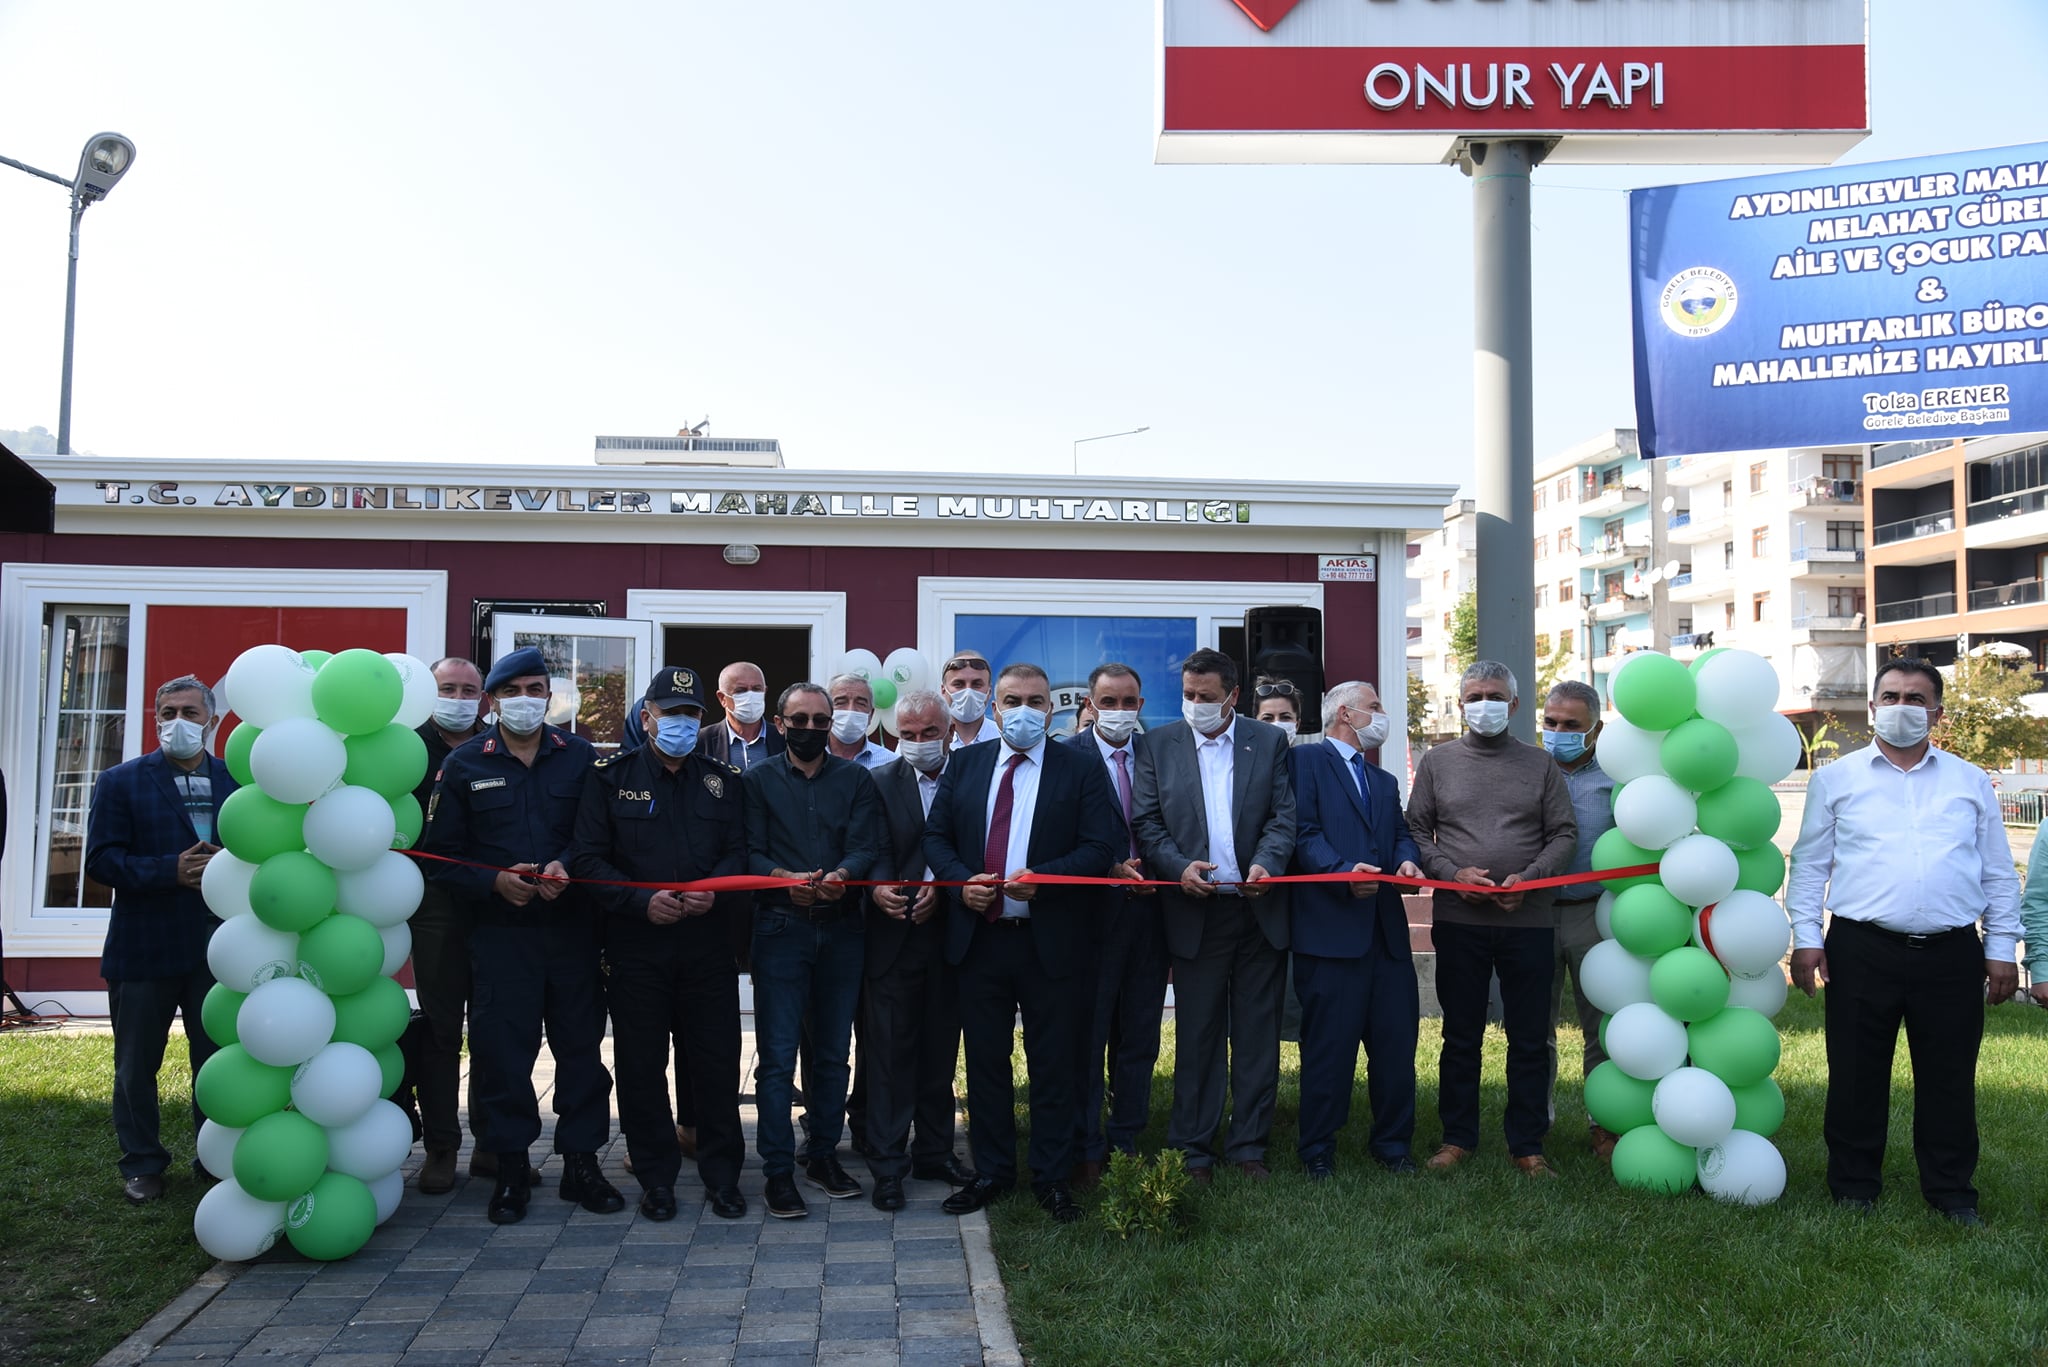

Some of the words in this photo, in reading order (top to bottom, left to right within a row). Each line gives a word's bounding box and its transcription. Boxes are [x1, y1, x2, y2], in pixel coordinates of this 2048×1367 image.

[1364, 61, 1534, 110] ONUR
[1548, 61, 1664, 109] YAPI
[1730, 174, 1957, 219] AYDINLIKEVLER
[1808, 207, 1950, 243] MELAHAT
[1771, 248, 1837, 279] AİLE
[1843, 248, 1880, 272] VE
[1887, 236, 1993, 274] ÇOCUK
[2001, 229, 2048, 257] PA
[1917, 277, 1947, 302] &
[1781, 313, 1955, 349] MUHTARLIK
[1962, 302, 2048, 334] BÜRO
[1713, 346, 1919, 387] MAHALLEMİZE
[1866, 394, 1916, 411] Tolga
[1924, 386, 2007, 407] ERENER
[1866, 416, 1904, 428] Görele
[1907, 412, 1957, 425] Belediye
[1960, 409, 2007, 423] Başkanı
[95, 481, 197, 506] T.C.
[213, 483, 652, 513] AYDINLIKEVLER
[670, 491, 919, 516] MAHALLE
[937, 495, 1250, 523] MUHTARLIĞI
